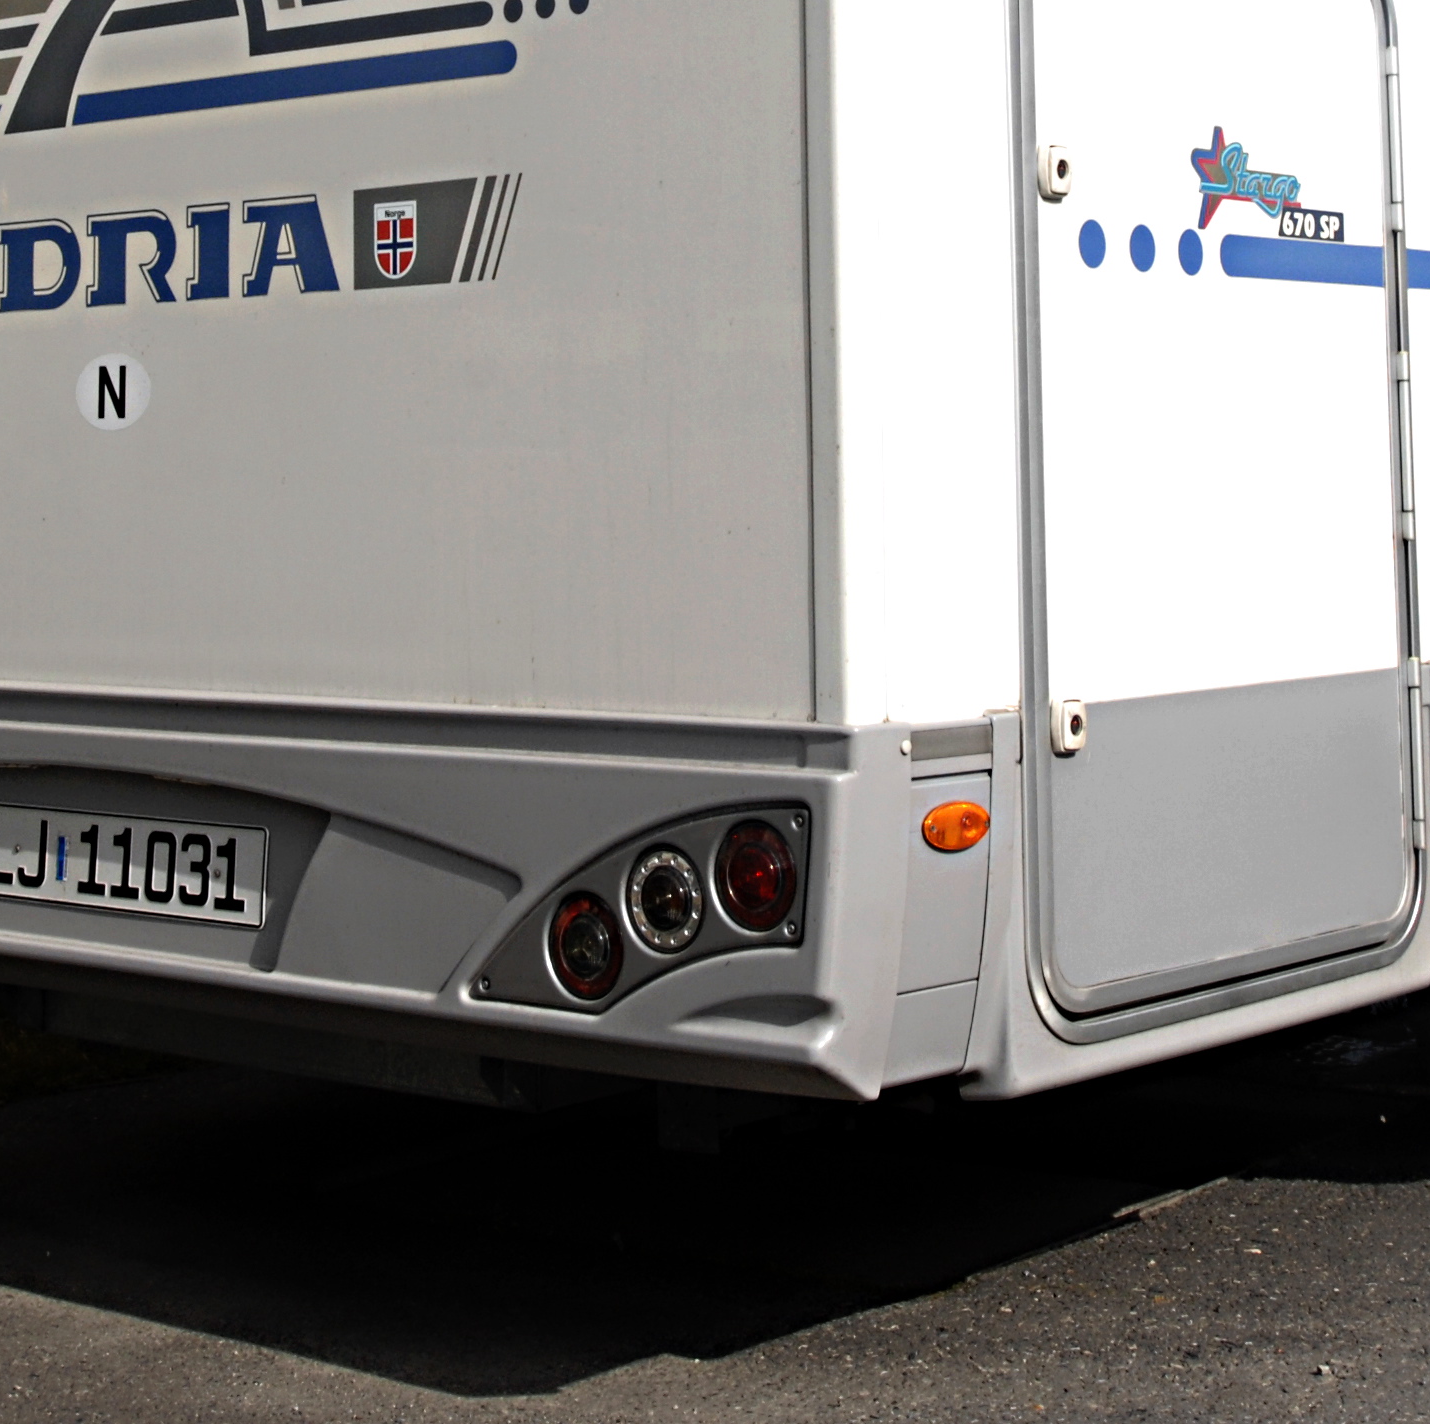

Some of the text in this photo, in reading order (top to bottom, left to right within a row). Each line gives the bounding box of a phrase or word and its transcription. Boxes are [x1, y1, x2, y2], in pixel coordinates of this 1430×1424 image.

[1199, 142, 1301, 219] Stargo
[1282, 211, 1340, 240] 670 SP
[97, 364, 127, 419] N
[77, 824, 246, 913] 11031
